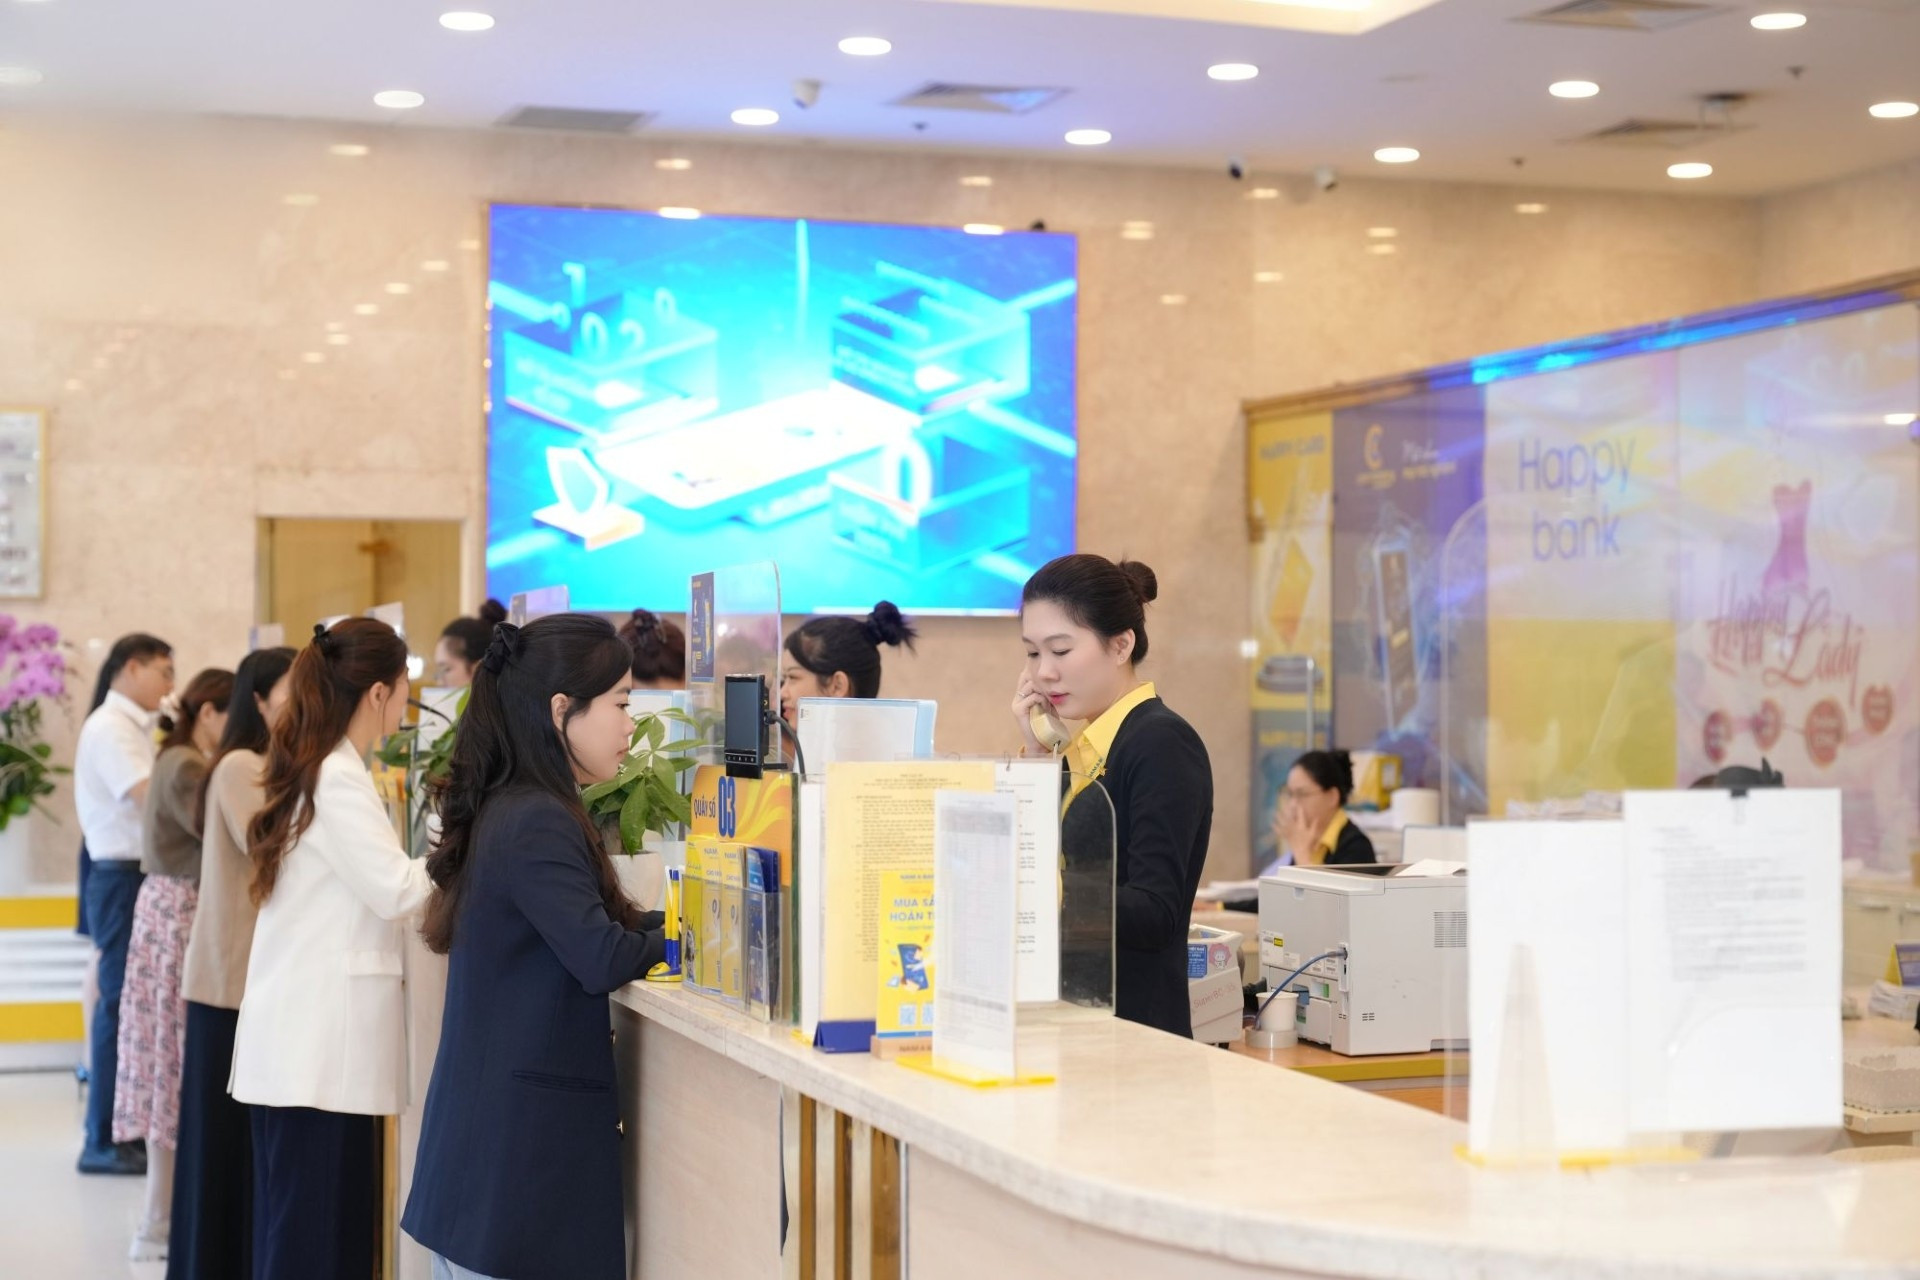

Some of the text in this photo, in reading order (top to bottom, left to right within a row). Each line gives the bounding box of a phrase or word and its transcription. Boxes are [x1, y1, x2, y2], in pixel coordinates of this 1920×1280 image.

[1518, 437, 1636, 500] Happy
[1531, 501, 1621, 562] bank
[1762, 585, 1866, 712] Lady
[718, 776, 735, 838] 03
[894, 898, 919, 908] MUA
